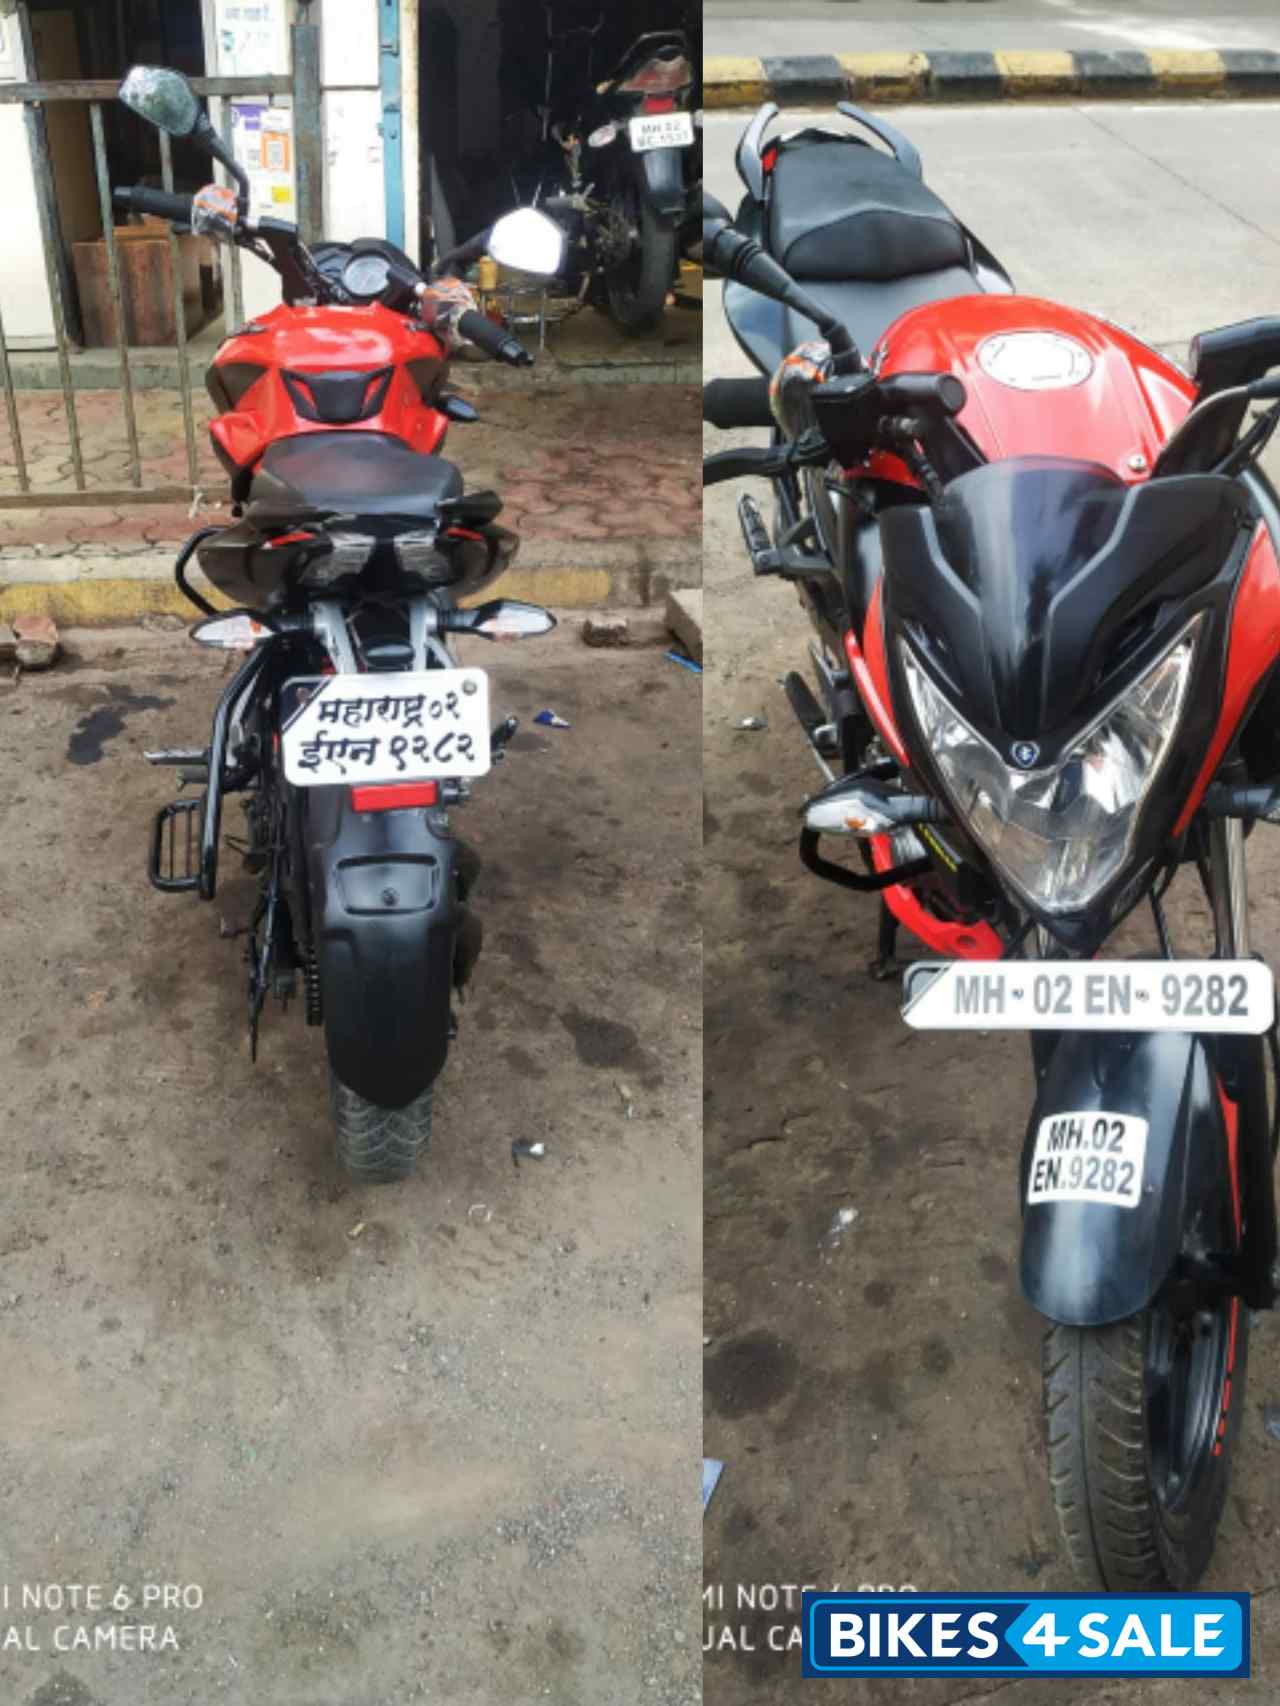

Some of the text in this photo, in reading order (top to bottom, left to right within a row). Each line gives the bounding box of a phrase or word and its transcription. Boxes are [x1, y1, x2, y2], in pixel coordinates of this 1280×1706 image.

[298, 730, 382, 774] ईएन
[954, 973, 1249, 1017] MH 02 EN 9282
